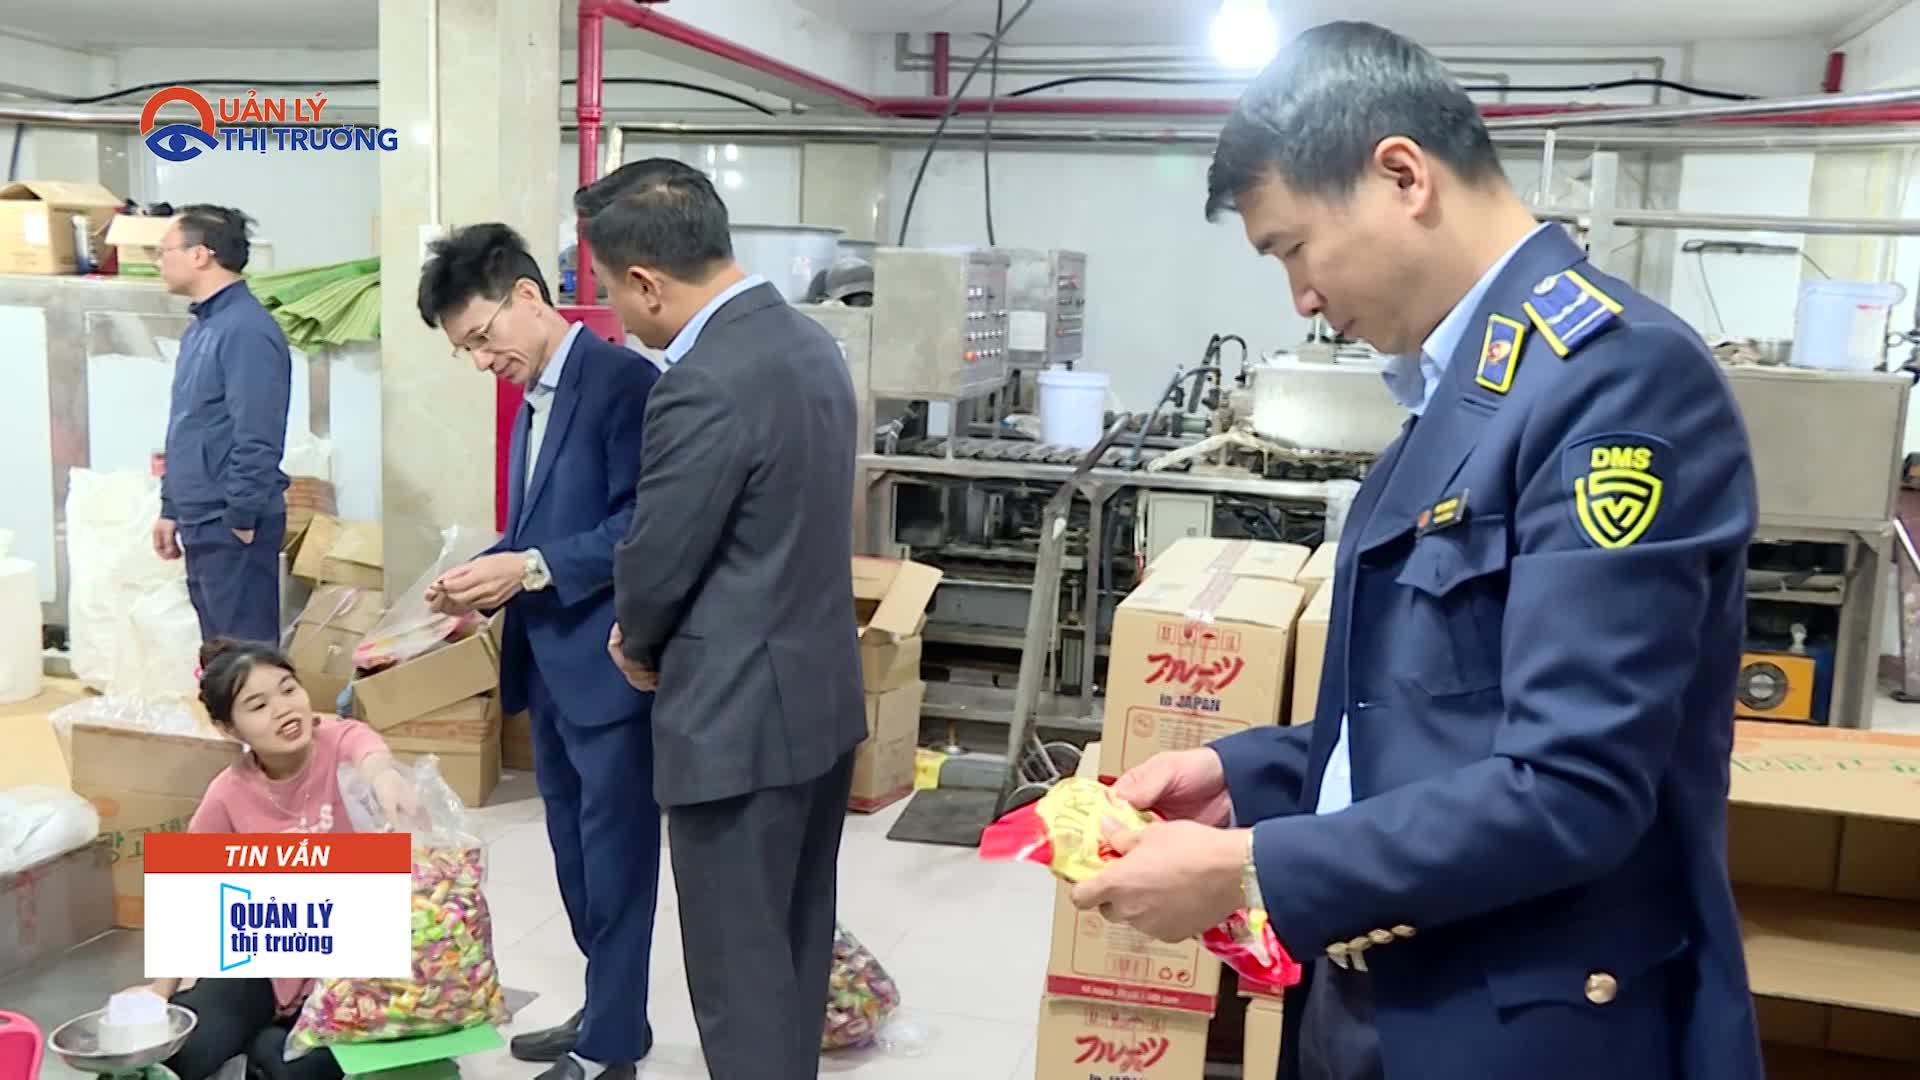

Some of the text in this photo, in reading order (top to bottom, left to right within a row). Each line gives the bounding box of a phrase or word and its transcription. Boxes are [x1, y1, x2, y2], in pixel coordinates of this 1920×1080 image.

[1591, 447, 1652, 470] DMS
[1144, 653, 1245, 690] フルーツ
[1176, 695, 1221, 712] JAPAN
[1073, 1035, 1169, 1068] フルーツ
